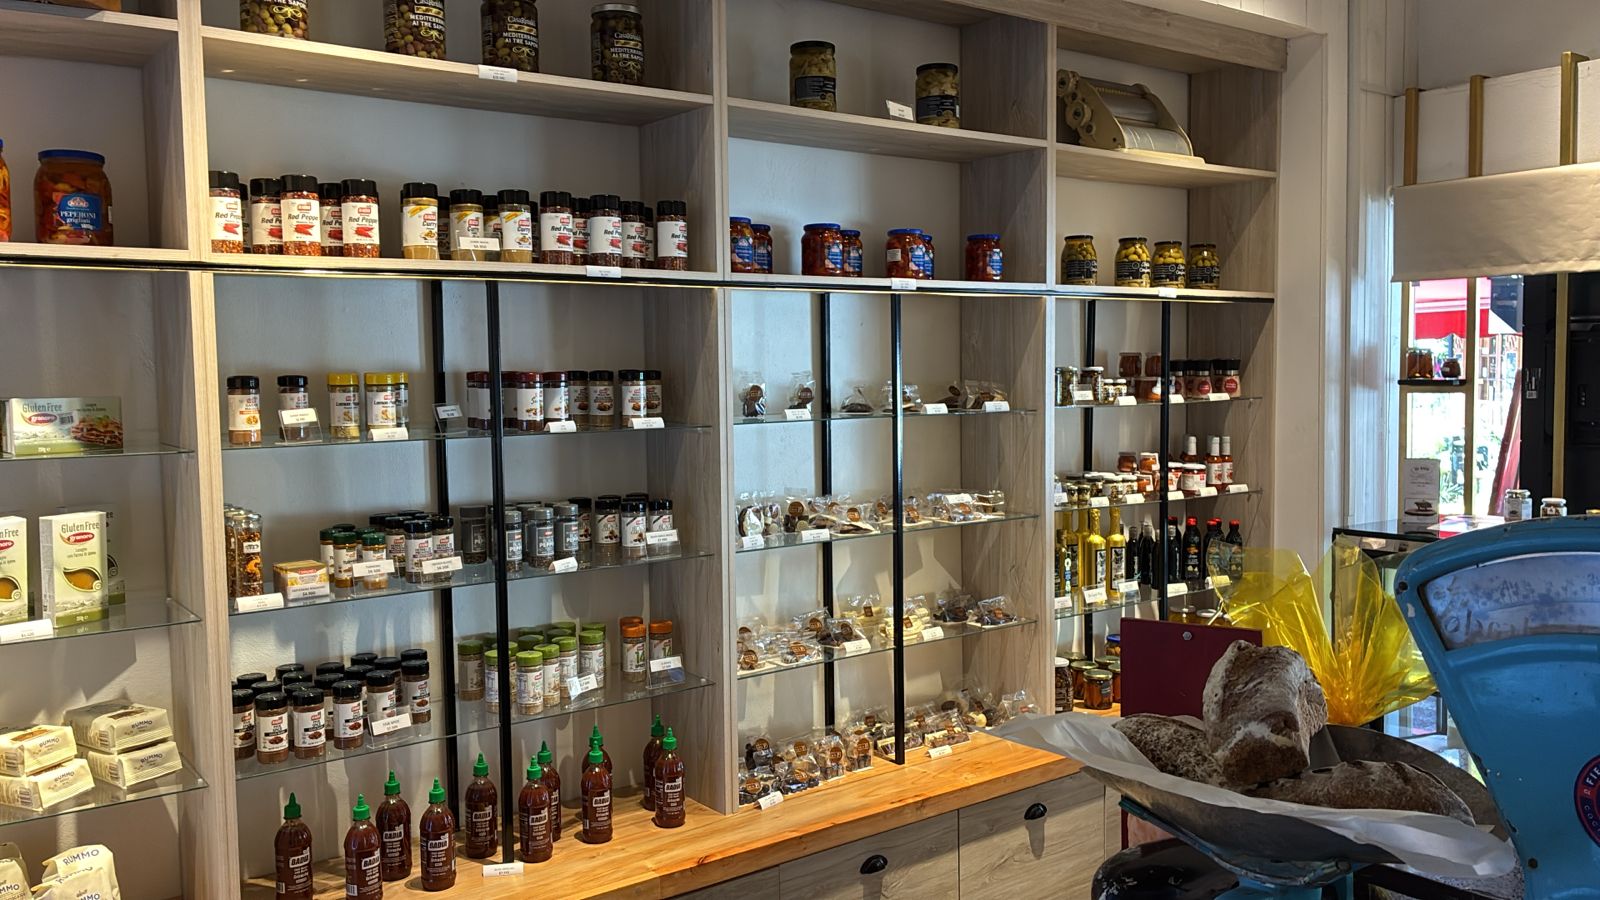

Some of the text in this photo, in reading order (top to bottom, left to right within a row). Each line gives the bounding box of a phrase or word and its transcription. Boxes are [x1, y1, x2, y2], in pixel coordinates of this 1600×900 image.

[422, 221, 437, 229] Curry
[22, 402, 62, 413] Gluten Free
[4, 528, 19, 538] Free
[61, 522, 100, 534] Gluten Free
[635, 650, 645, 664] 14
[132, 720, 153, 729] RUMMO
[39, 737, 60, 747] RUMMO
[140, 752, 163, 764] RUMMO
[54, 770, 75, 782] RUMMO
[666, 783, 682, 791] BADIA
[594, 797, 610, 805] BADIA
[474, 812, 491, 820] BADIA
[531, 815, 547, 823] BADIA
[384, 832, 402, 840] BADIA
[429, 840, 447, 850] BADIA
[62, 849, 100, 866] RUMMO
[291, 855, 309, 866] BADIA
[363, 857, 380, 868] BADIA
